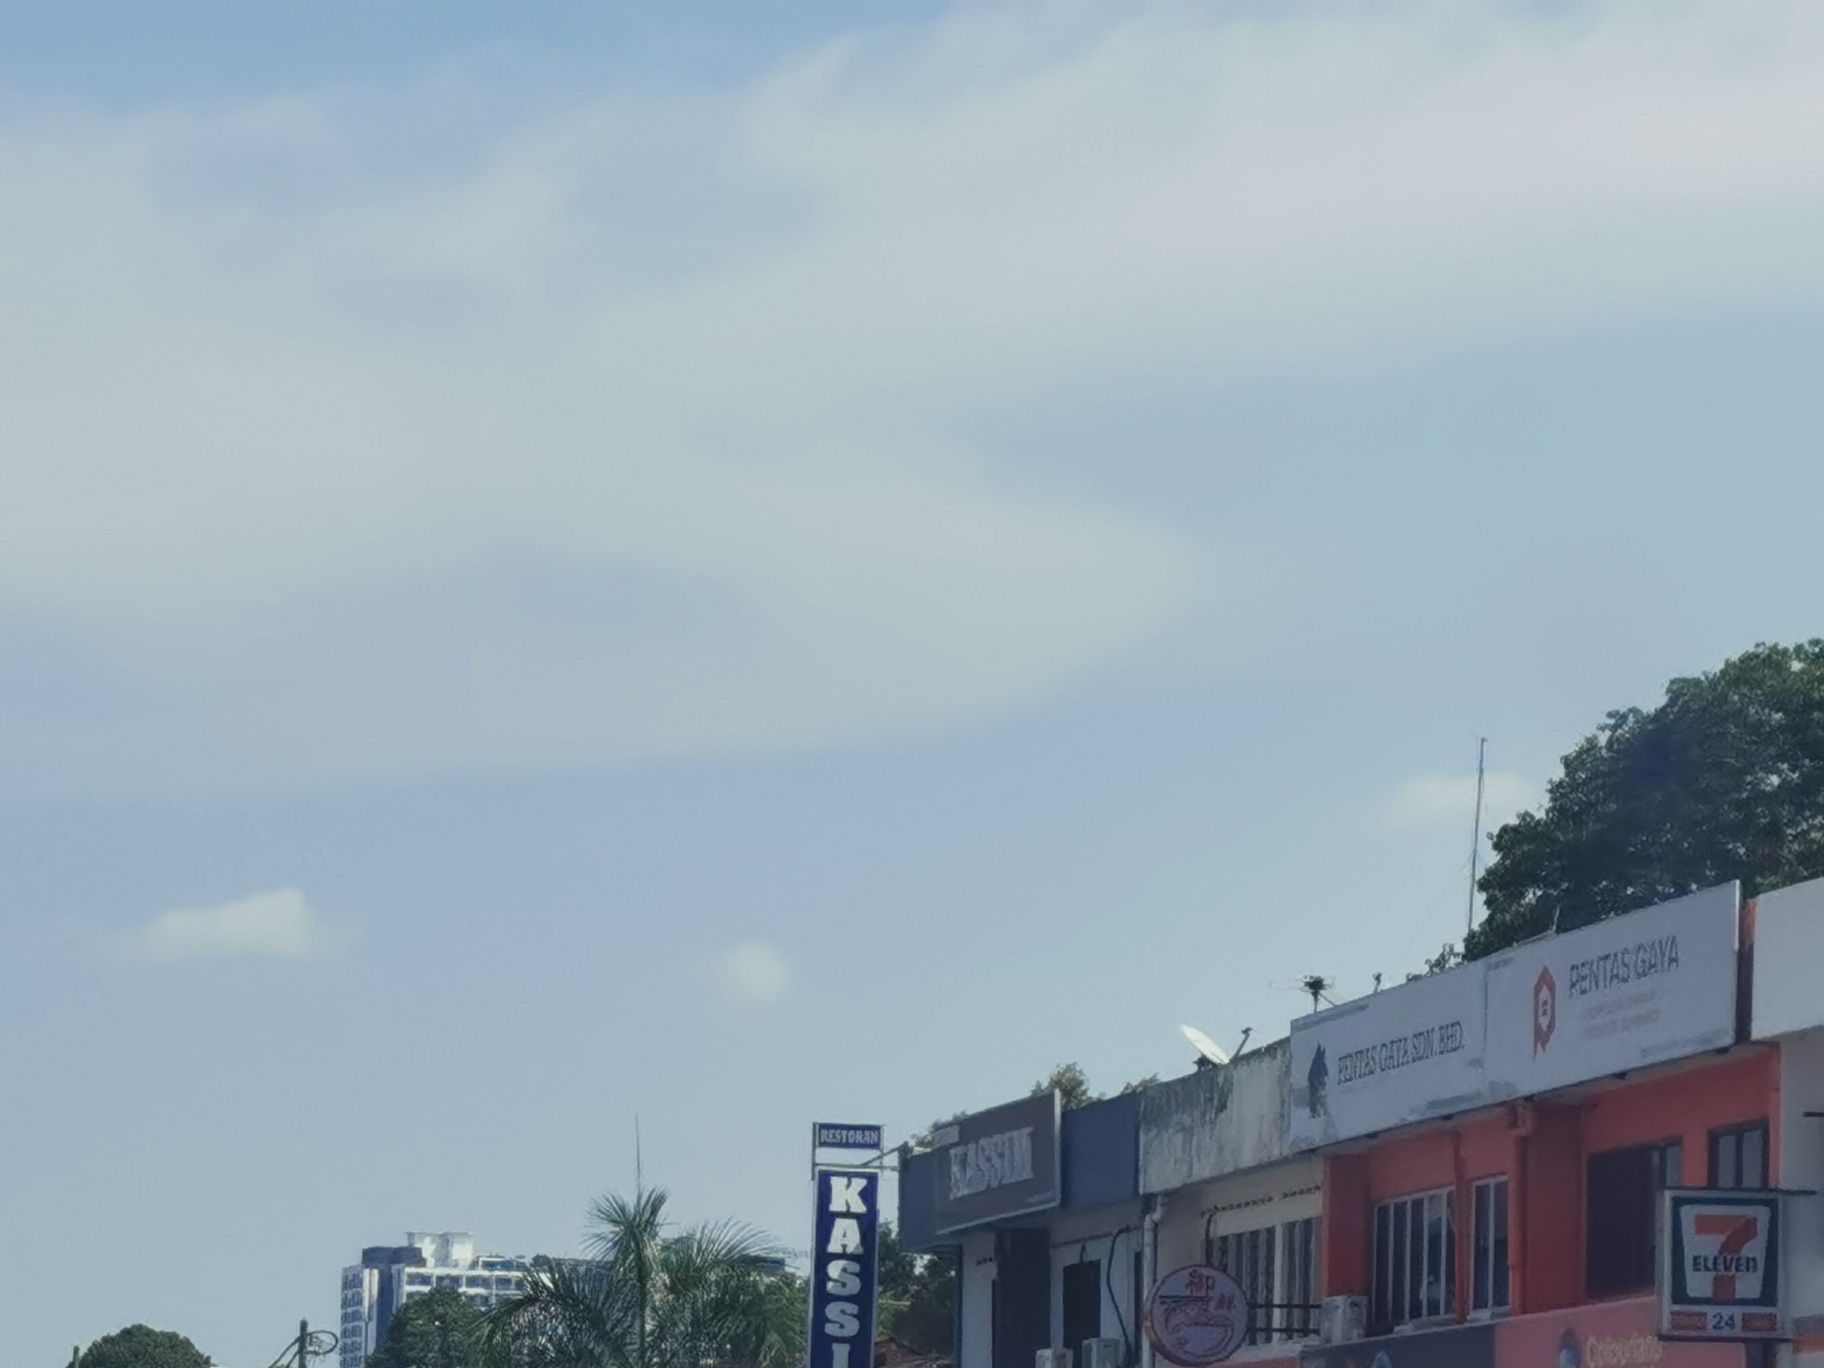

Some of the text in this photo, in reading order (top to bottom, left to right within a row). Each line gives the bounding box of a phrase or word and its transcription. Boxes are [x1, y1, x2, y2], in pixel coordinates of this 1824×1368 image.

[1567, 934, 1680, 998] PENTAS GAYA
[819, 1127, 879, 1145] RESTORAN
[1694, 1213, 1758, 1304] 7
[1712, 1312, 1736, 1331] 24
